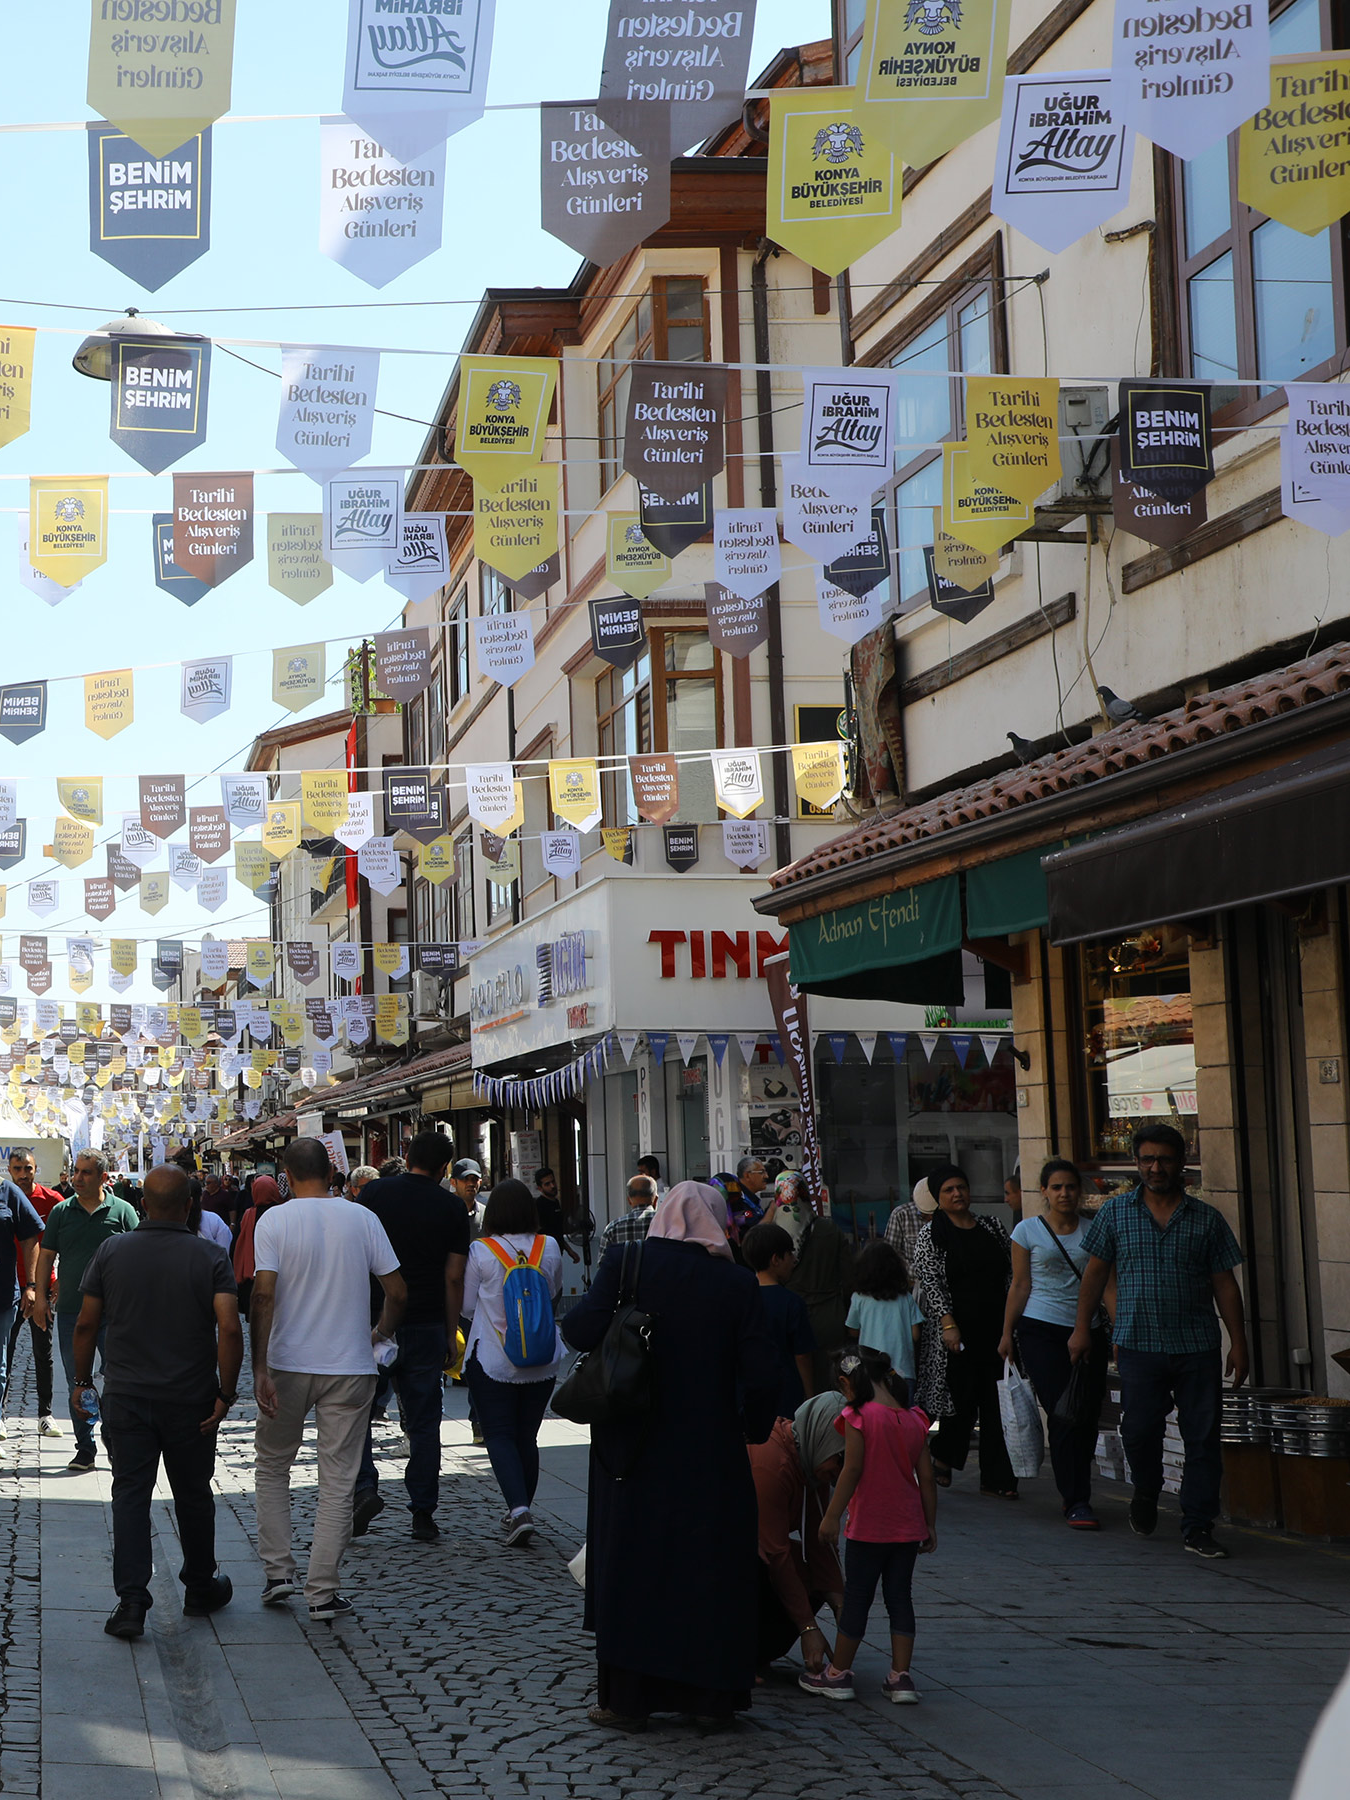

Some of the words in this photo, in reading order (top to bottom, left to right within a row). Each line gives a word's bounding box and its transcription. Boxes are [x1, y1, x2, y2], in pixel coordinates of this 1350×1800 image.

[1044, 95, 1100, 112] UĞUR
[1018, 126, 1117, 167] Altay
[331, 167, 435, 190] Bedesten
[560, 163, 649, 190] Alışveriş
[814, 167, 860, 182] KONYA
[791, 179, 883, 201] BÜYÜKŞEHİR
[340, 191, 424, 215] Alışveriş
[566, 191, 643, 216] Günleri
[809, 194, 864, 209] BELEDİYESİ
[344, 218, 417, 239] Günleri
[305, 363, 356, 383] Tarihi
[287, 384, 367, 406] Bedesten
[651, 381, 704, 400] Tarihi
[831, 392, 871, 407] UĞUR
[988, 390, 1041, 407] Tarihi
[291, 406, 357, 428] Alışveriş
[485, 414, 516, 425] KONYA
[634, 402, 717, 423] Bedesten
[975, 409, 1053, 430] Bedesten
[294, 430, 351, 448] Günleri
[469, 423, 530, 438] BÜYÜKŞEHİR
[640, 424, 709, 445] Alışveriş
[815, 417, 883, 447] Altay
[479, 436, 516, 446] BELEDİYESİ
[986, 431, 1050, 449] Alışveriş
[643, 447, 704, 464] Günleri
[992, 451, 1048, 467] Günleri
[189, 487, 235, 504] Tarihi
[178, 505, 247, 522] Bedesten
[42, 531, 96, 543] BÜYÜKŞEHİR
[56, 524, 83, 533] KONYA
[184, 524, 241, 540] Alışveriş
[53, 542, 84, 550] BELEDİYESİ
[188, 541, 237, 556] Günleri
[818, 911, 863, 944] Adnan
[868, 889, 919, 947] Efendi
